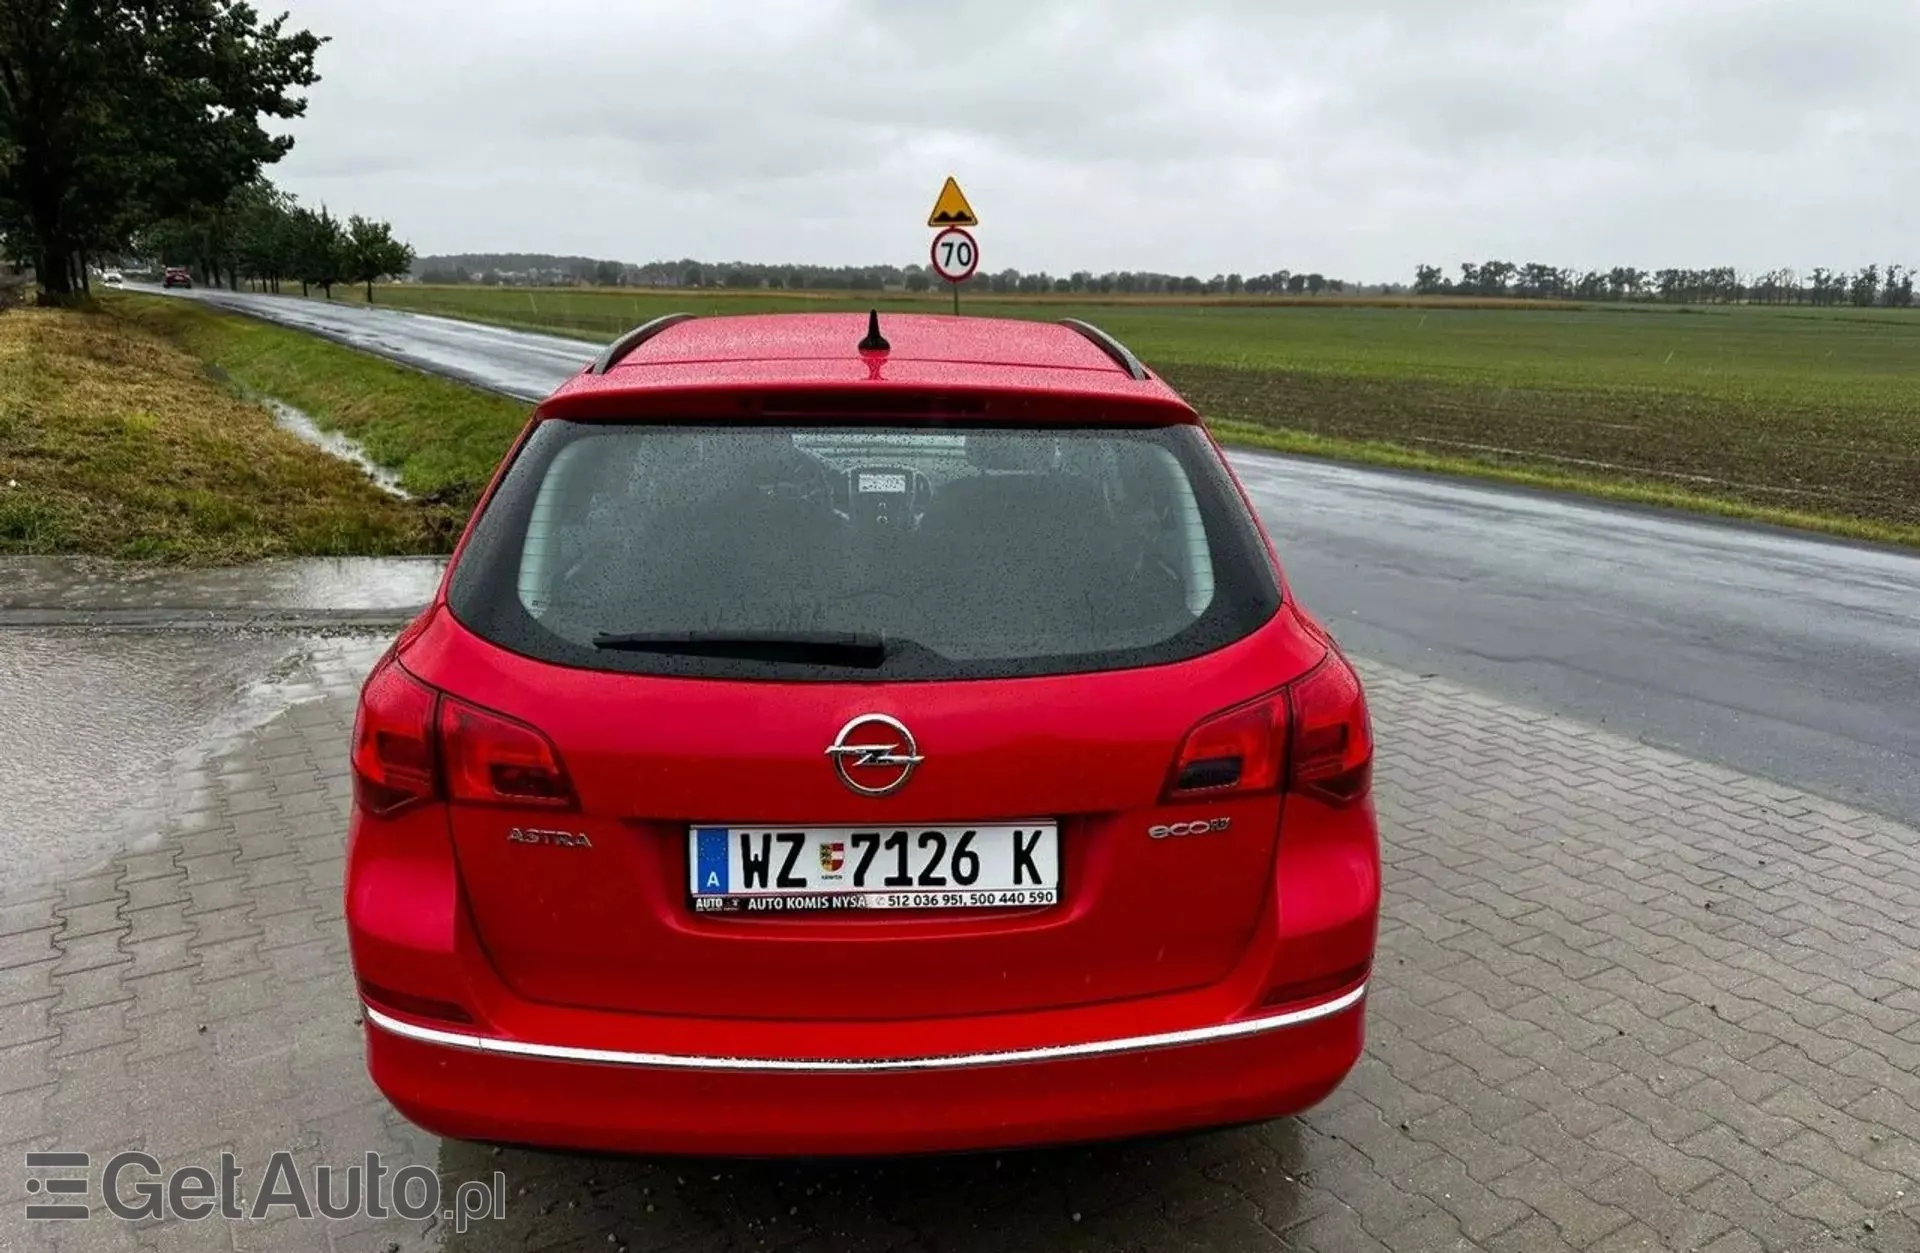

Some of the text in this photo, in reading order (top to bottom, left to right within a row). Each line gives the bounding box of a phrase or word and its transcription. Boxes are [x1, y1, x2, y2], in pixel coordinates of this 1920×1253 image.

[941, 242, 972, 267] 70
[507, 828, 593, 847] ASTRA
[740, 830, 1042, 889] WZ 7126 K
[706, 871, 720, 887] A
[696, 898, 723, 908] AUTO
[748, 897, 783, 910] AUTO
[786, 896, 829, 910] KOMIS
[832, 895, 867, 909] NYSA
[888, 895, 910, 907] 512
[913, 894, 939, 906] 036
[970, 893, 996, 905] 500
[998, 892, 1025, 904] 440
[1028, 891, 1054, 903] 590
